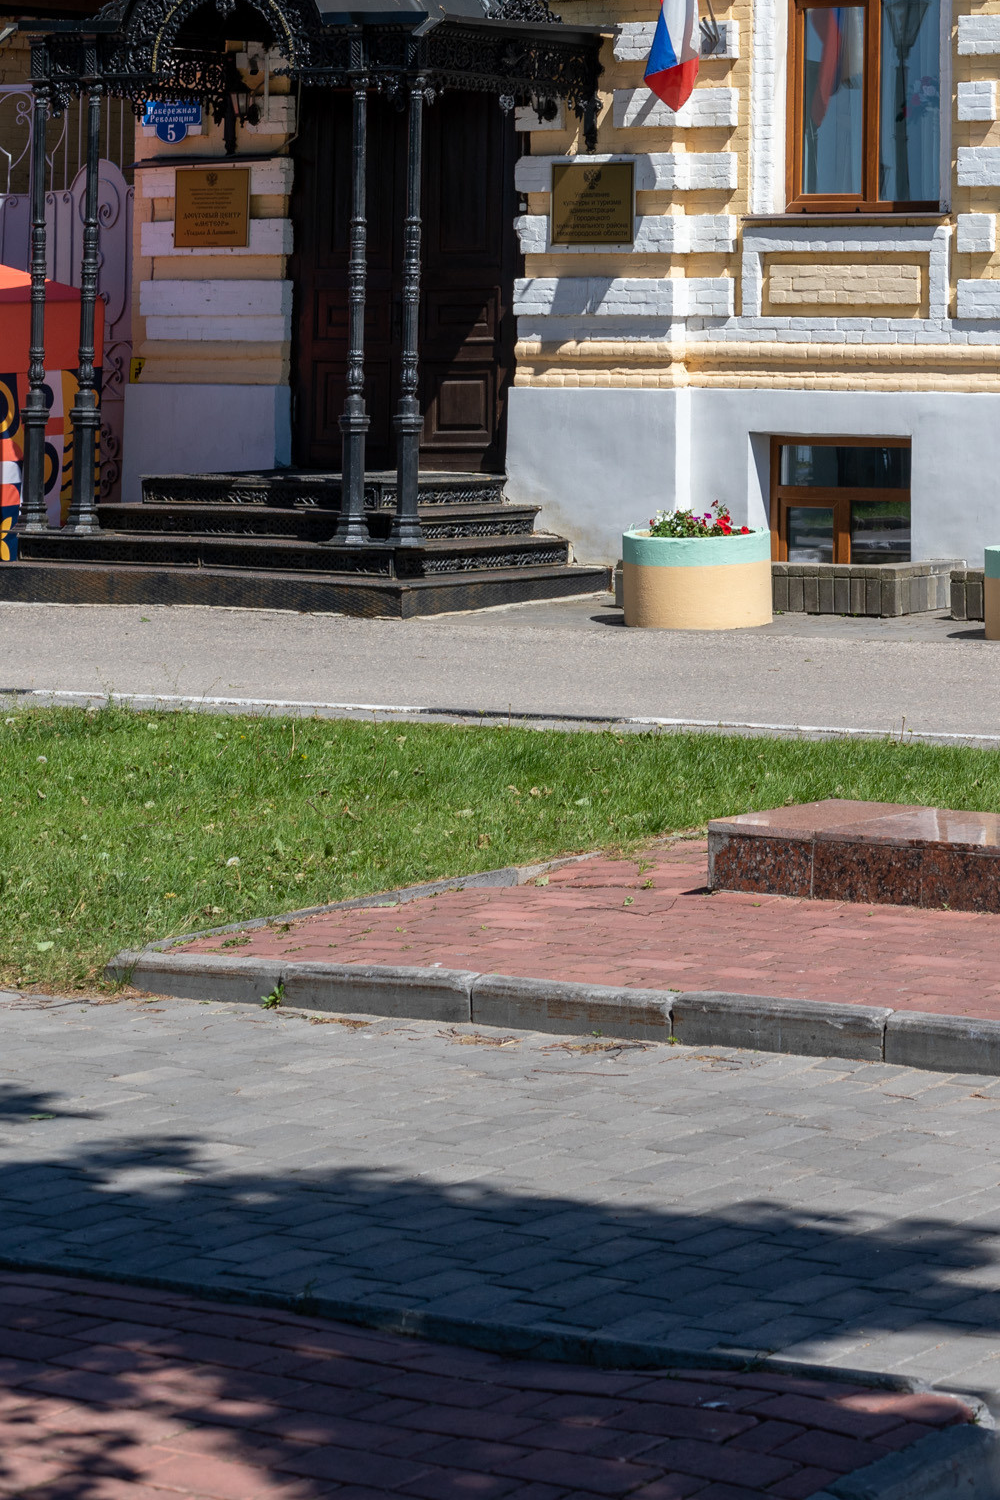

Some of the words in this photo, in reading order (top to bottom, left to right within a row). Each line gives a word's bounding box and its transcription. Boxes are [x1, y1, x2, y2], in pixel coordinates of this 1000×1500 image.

[148, 106, 196, 116] Набережная
[150, 114, 194, 123] Революции
[167, 124, 176, 141] 5
